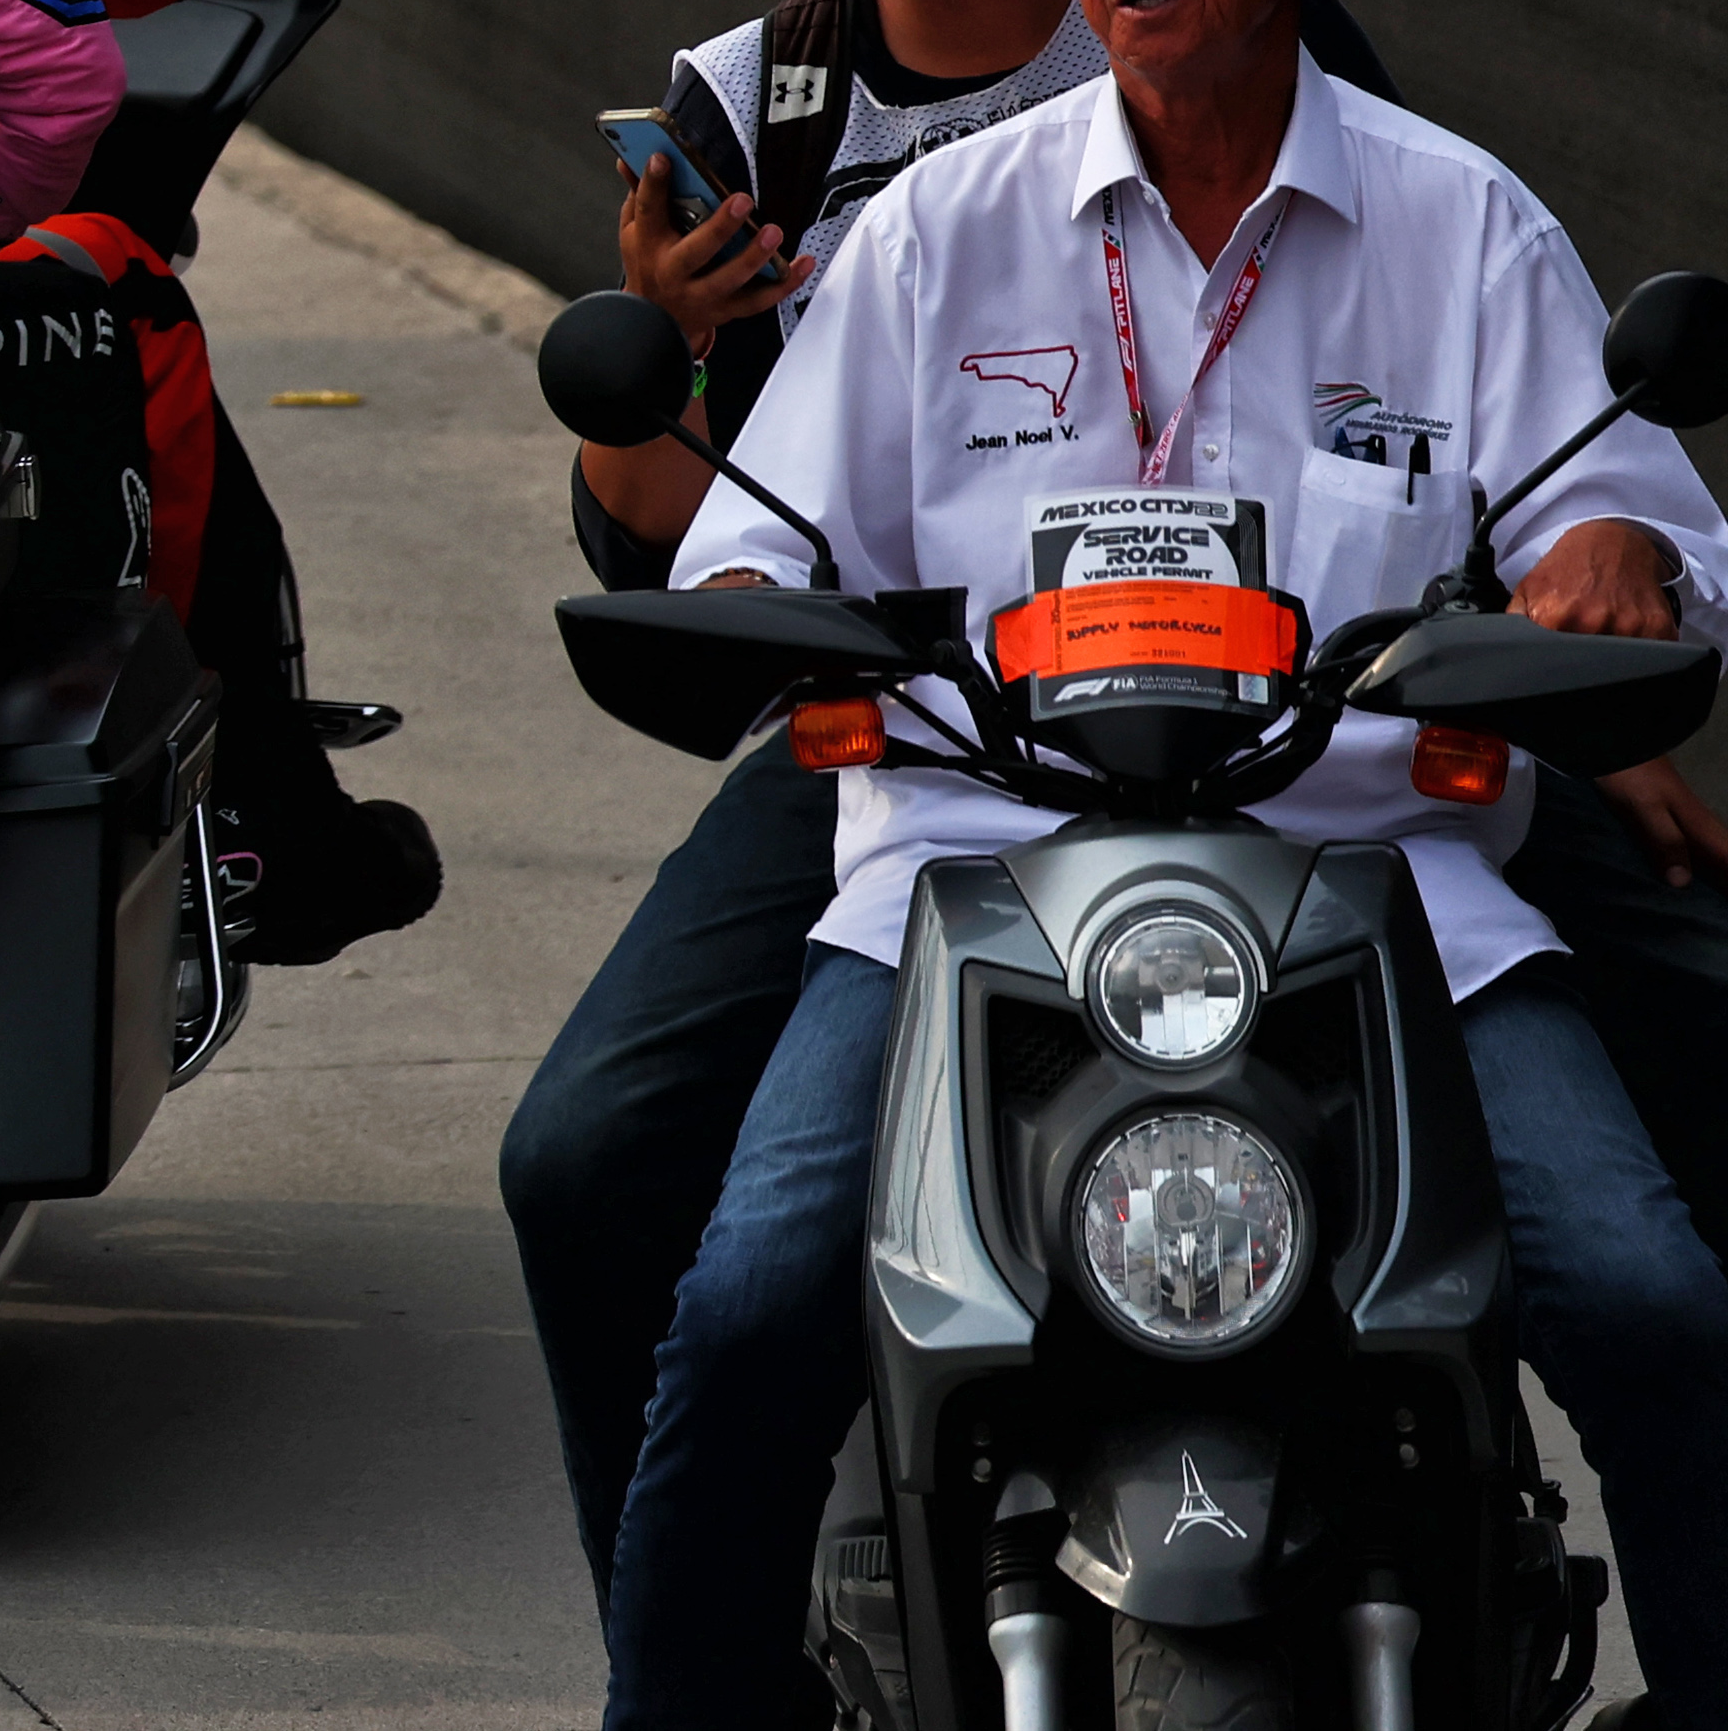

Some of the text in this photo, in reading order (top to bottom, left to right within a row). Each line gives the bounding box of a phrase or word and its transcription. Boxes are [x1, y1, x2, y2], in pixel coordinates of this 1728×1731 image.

[1108, 257, 1127, 328] PITLANE
[1218, 275, 1255, 342] PITLANE
[965, 424, 1080, 451] Jean Noel V.
[1040, 498, 1138, 524] MEXICO
[1083, 525, 1211, 549] SERVICE
[1105, 546, 1189, 566] ROAD
[1082, 566, 1214, 581] VEHICLE PERMIT
[1066, 621, 1120, 643] SUPPLY
[1113, 676, 1137, 690] FIA
[1139, 682, 1229, 696] World Championship
[1154, 675, 1193, 685] Formula
